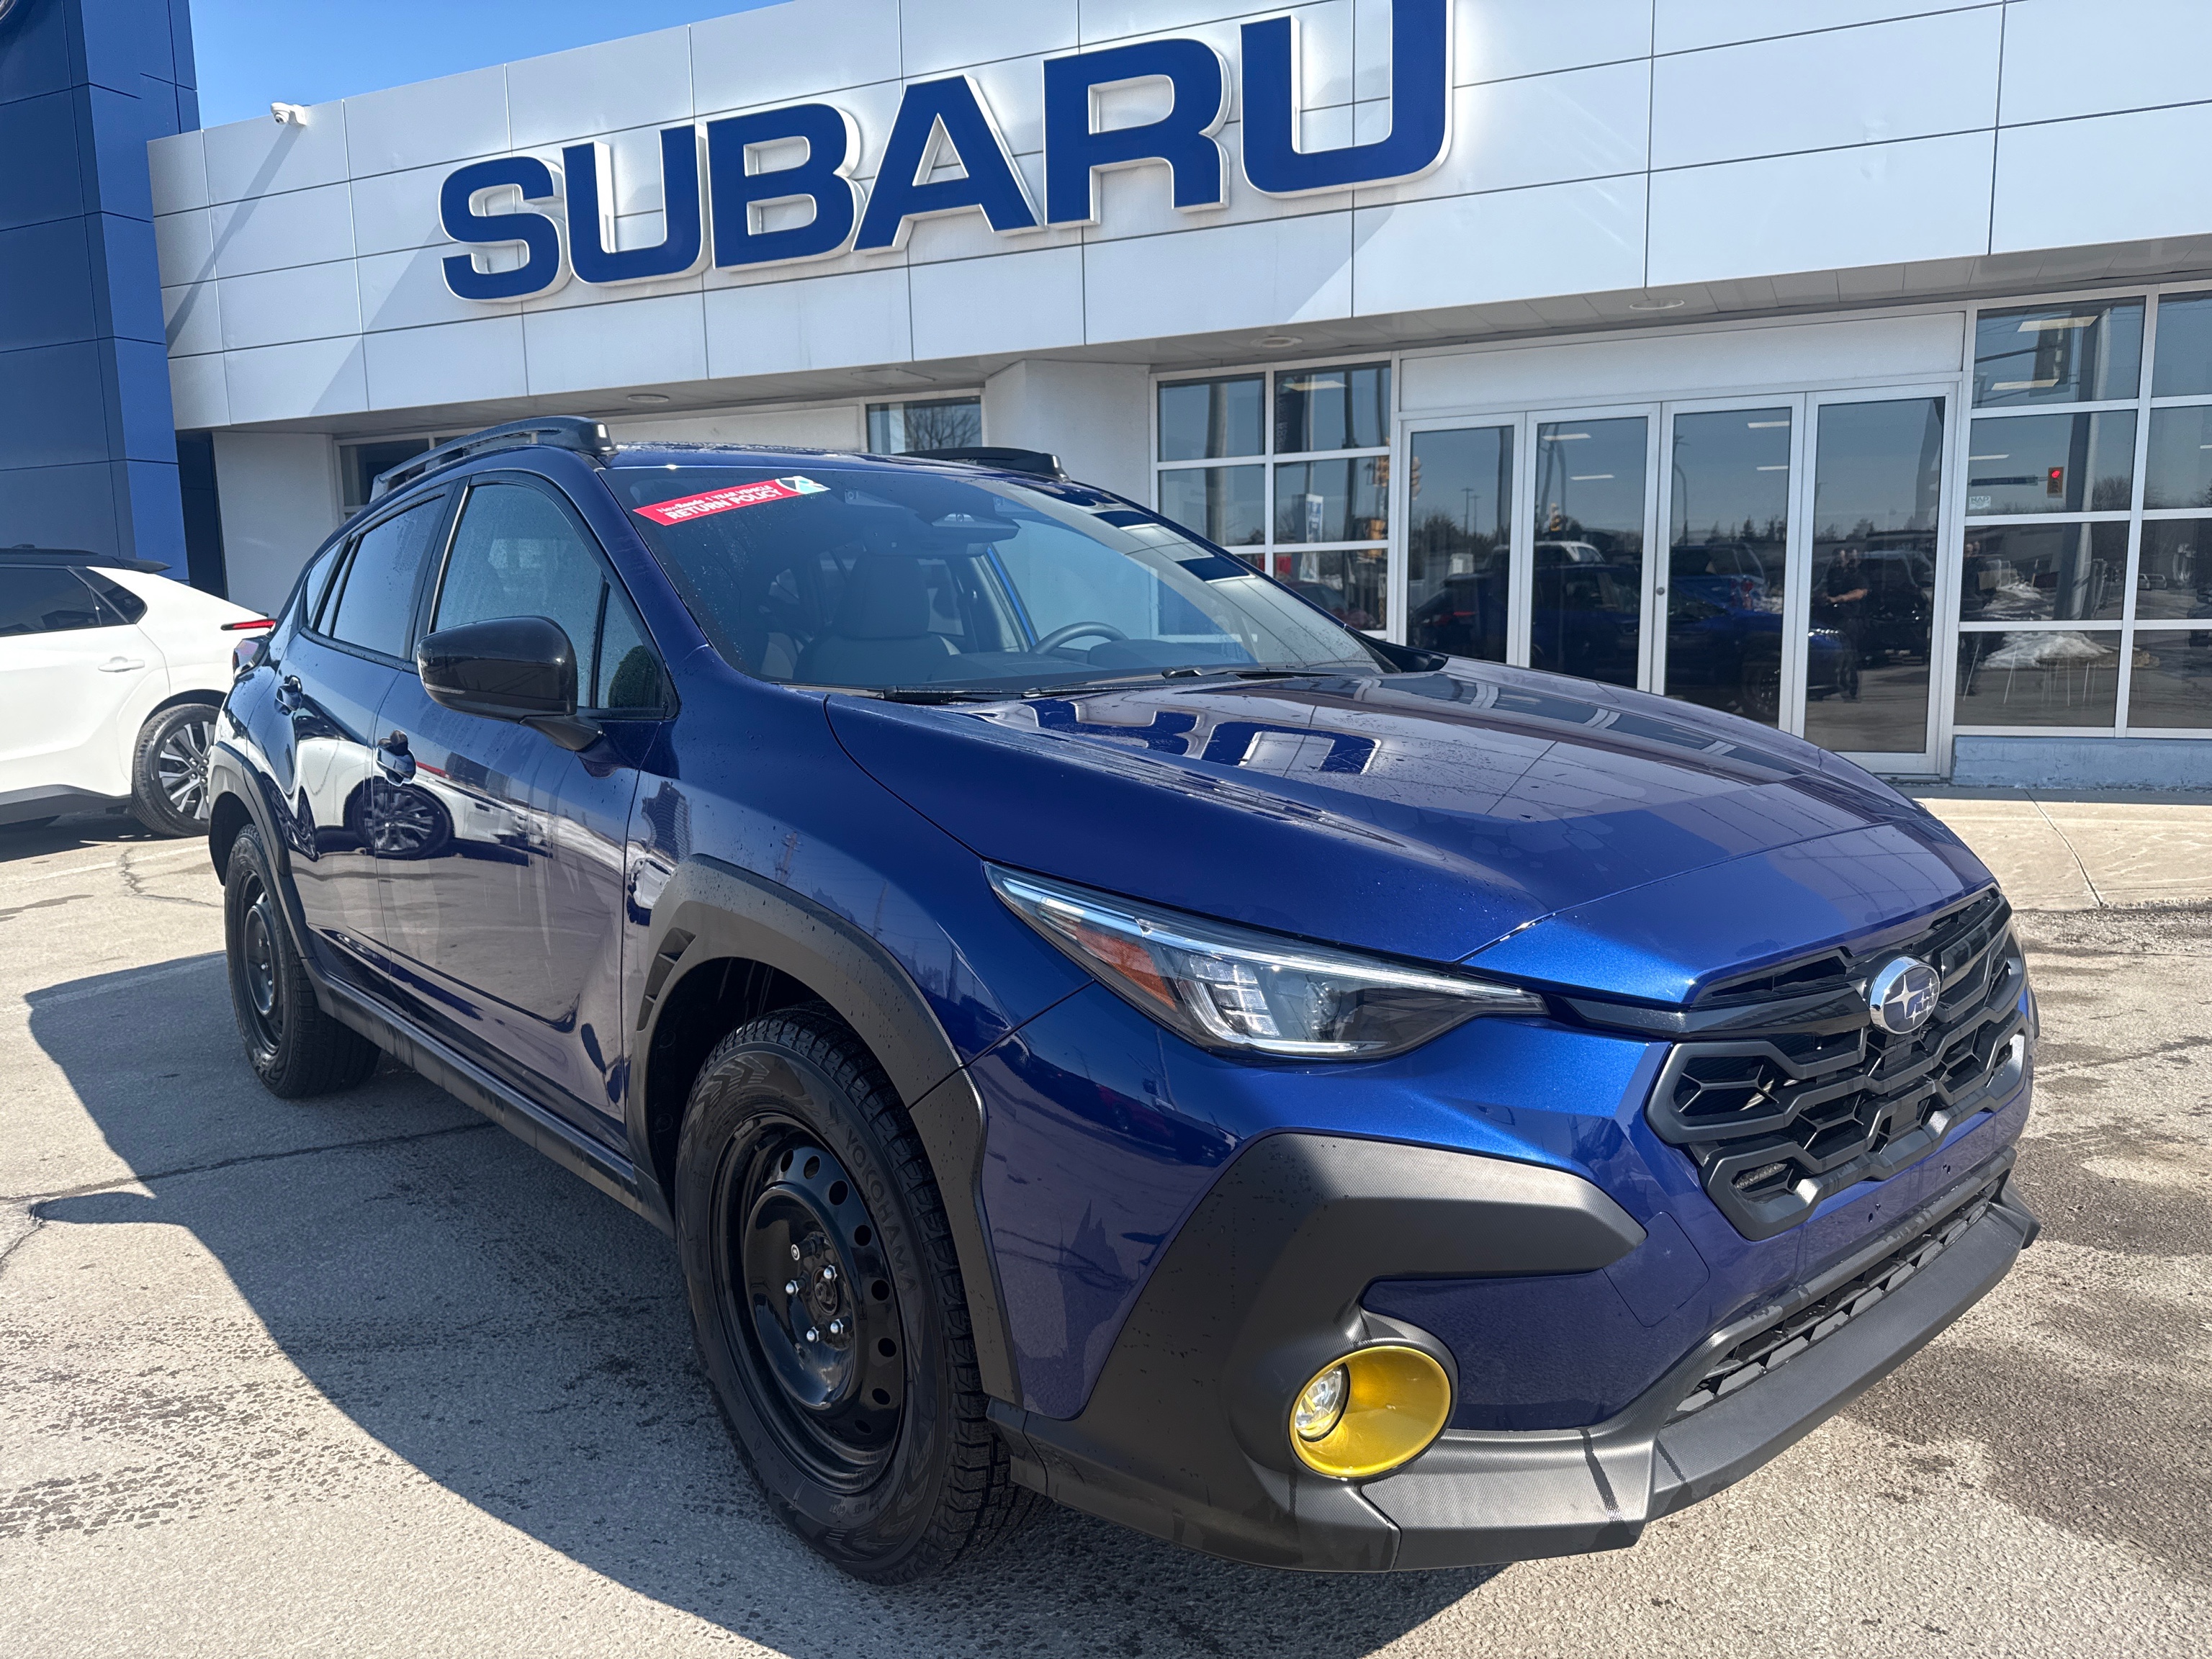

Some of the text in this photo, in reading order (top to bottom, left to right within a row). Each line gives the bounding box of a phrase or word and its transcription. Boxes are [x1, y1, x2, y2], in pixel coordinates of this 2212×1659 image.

[439, 0, 1449, 301] SUBARU
[665, 489, 783, 519] RETURN POLICY
[712, 491, 736, 500] YEAR
[736, 485, 773, 495] VEHICLE
[845, 1126, 918, 1298] YOKOHAMA
